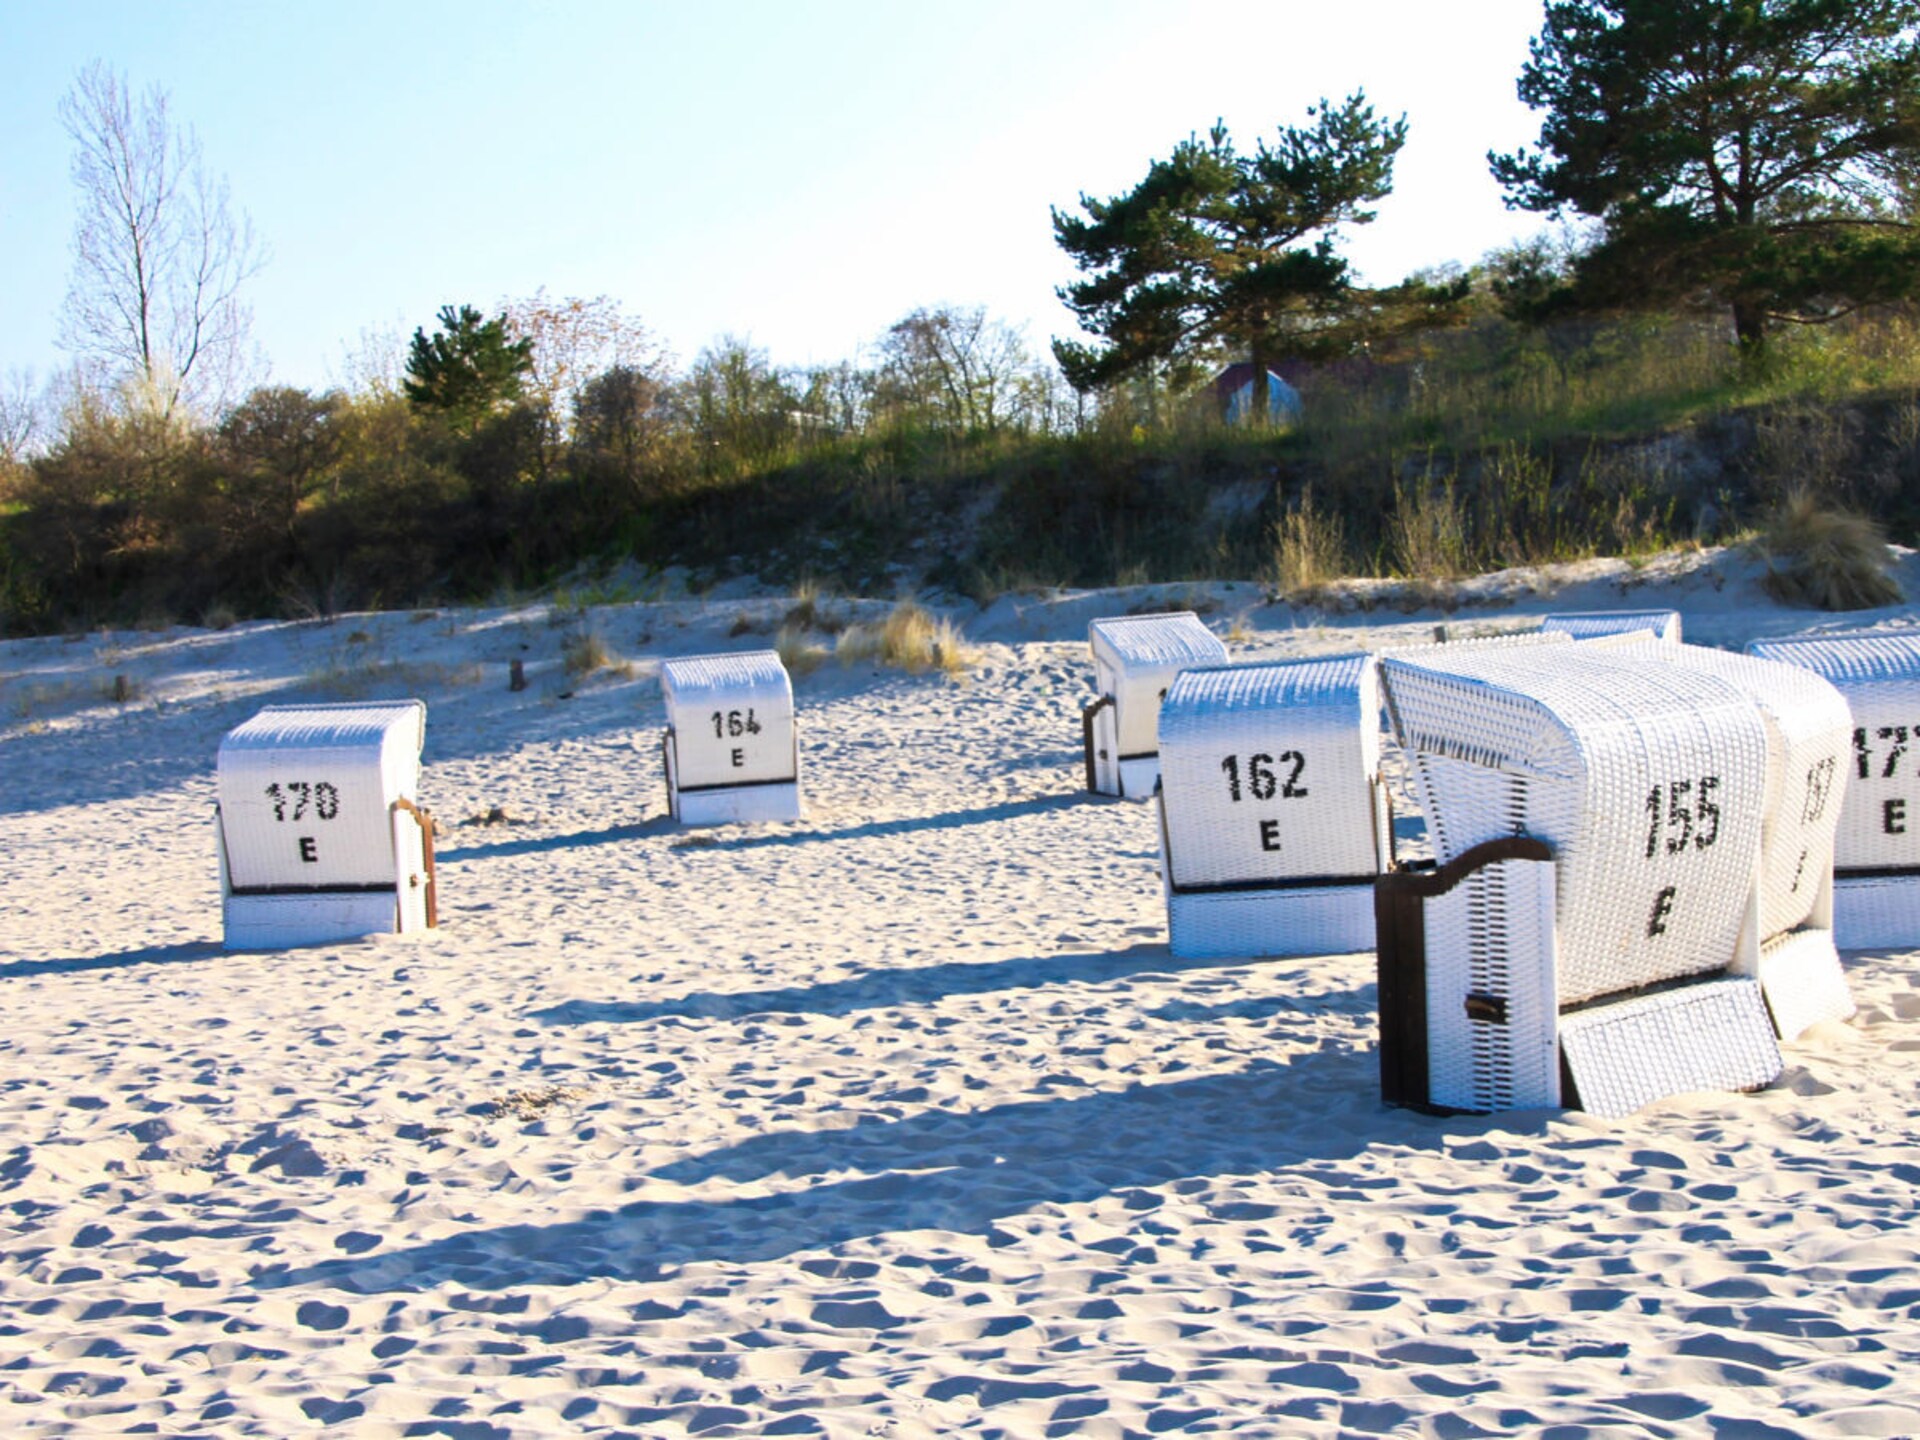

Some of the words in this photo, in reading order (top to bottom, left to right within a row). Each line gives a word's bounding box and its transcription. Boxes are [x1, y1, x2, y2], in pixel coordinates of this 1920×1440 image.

[712, 707, 762, 739] 164
[731, 748, 745, 768] E
[1852, 725, 1920, 779] 17
[1222, 750, 1309, 802] 162
[265, 781, 340, 822] 170
[1645, 775, 1720, 859] 155
[1883, 798, 1907, 835] E
[299, 836, 319, 863] E
[1259, 818, 1281, 852] E
[1648, 885, 1677, 939] E
